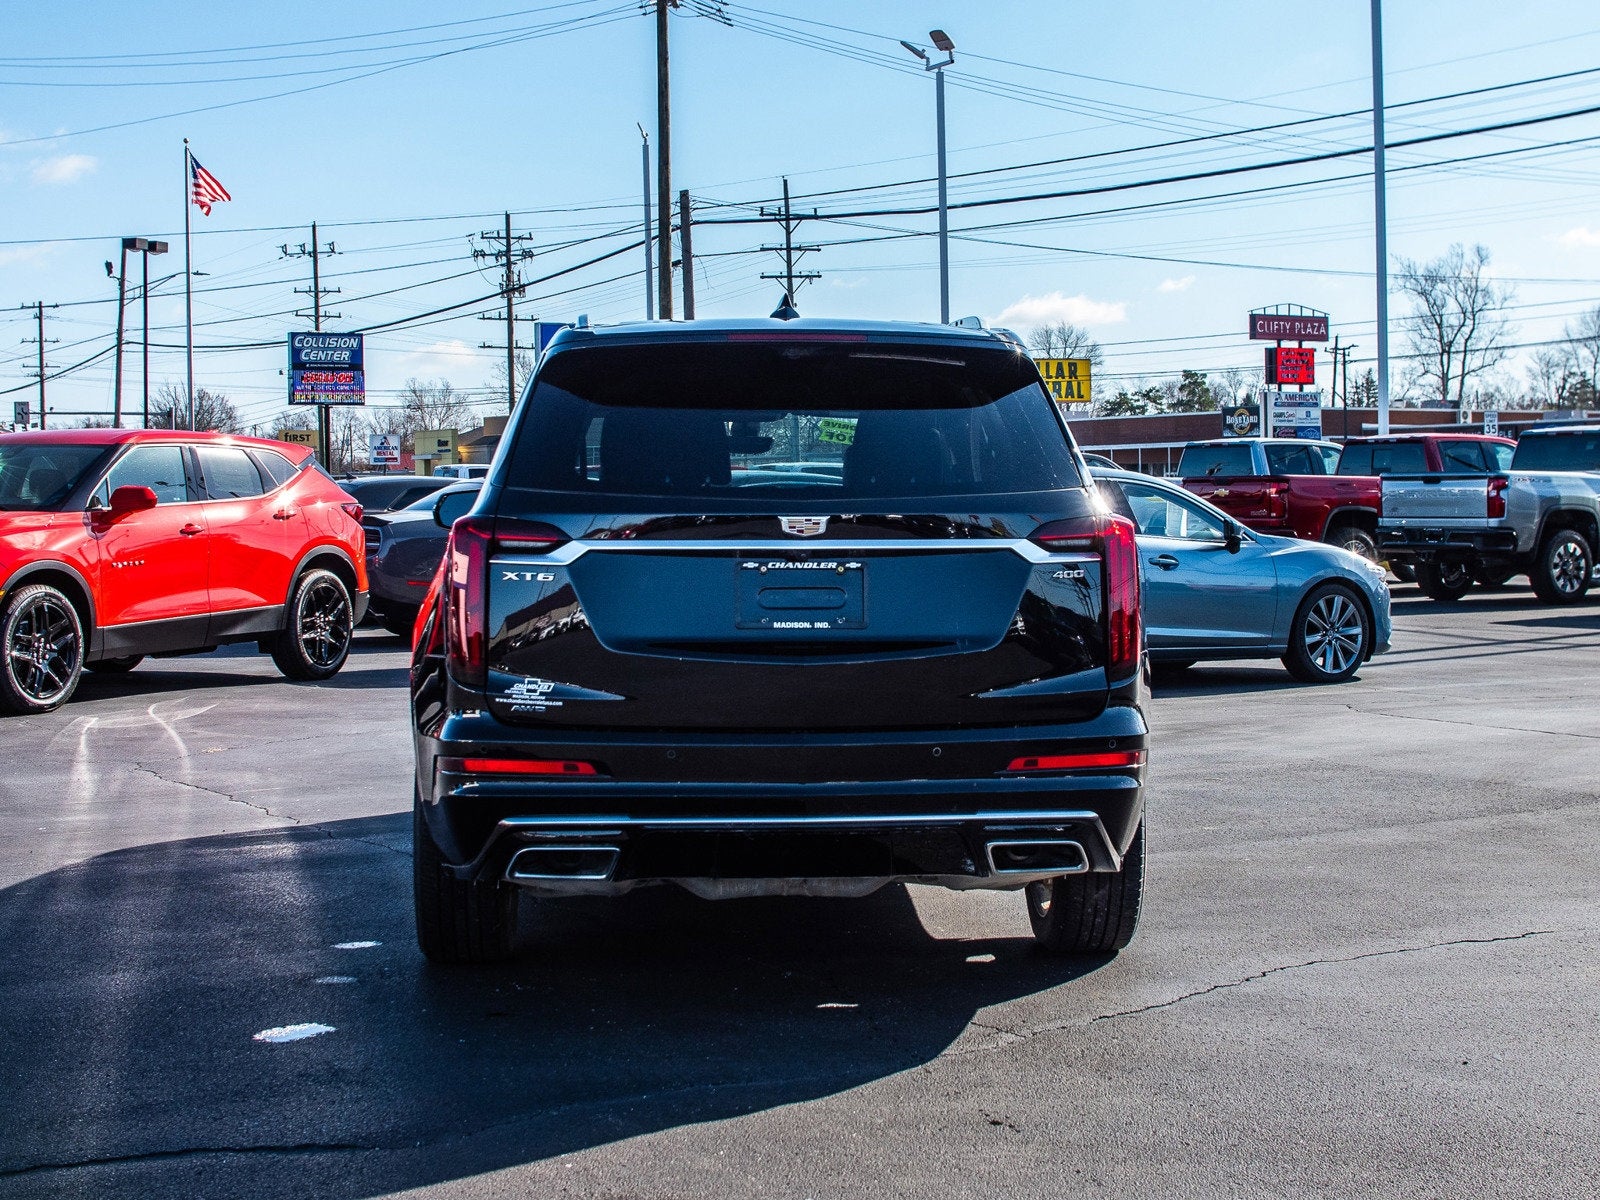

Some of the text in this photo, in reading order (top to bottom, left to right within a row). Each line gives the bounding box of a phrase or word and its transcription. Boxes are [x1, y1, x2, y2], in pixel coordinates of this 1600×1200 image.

[1257, 320, 1327, 335] CLIFTY PLAZA
[294, 335, 360, 348] COLLISION
[301, 349, 351, 361] CENTER
[1046, 381, 1084, 398] RAL
[1284, 393, 1318, 402] AMERICAN
[1486, 424, 1497, 434] 35
[502, 571, 556, 581] XT6
[1052, 569, 1085, 579] 400
[814, 621, 831, 629] IND.
